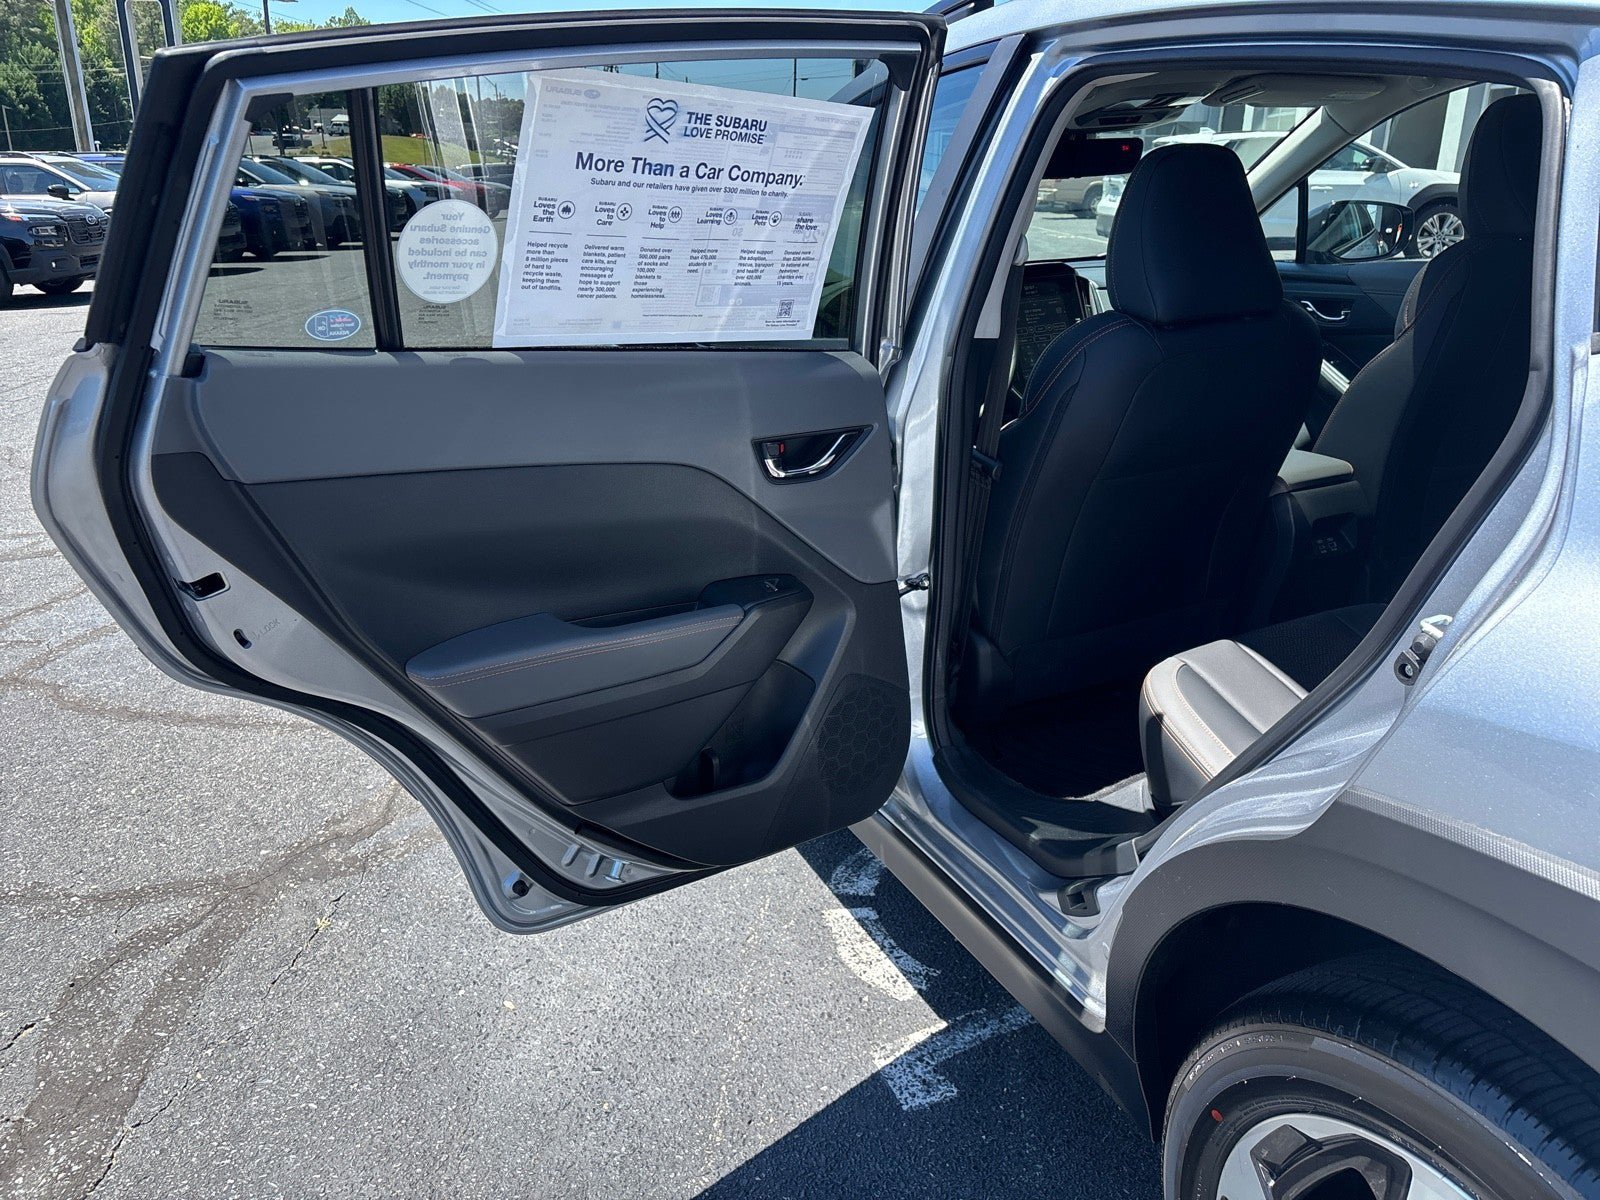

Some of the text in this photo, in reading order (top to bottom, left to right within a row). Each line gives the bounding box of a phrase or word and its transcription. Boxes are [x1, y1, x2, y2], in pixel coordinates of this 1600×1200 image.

[687, 112, 713, 126] THE
[715, 115, 767, 132] SUBARU
[683, 126, 713, 139] LOVE
[714, 129, 767, 145] PROMISE
[575, 151, 625, 173] More
[631, 156, 675, 177] Than
[679, 164, 690, 179] a
[695, 162, 724, 180] Car
[590, 177, 616, 186] Subaru
[645, 183, 673, 191] retailers
[674, 184, 690, 192] have
[691, 185, 708, 193] given
[723, 186, 738, 194] $300
[739, 188, 760, 196] million
[768, 190, 789, 199] charity.
[533, 201, 556, 209] Loves
[650, 221, 665, 229] Help
